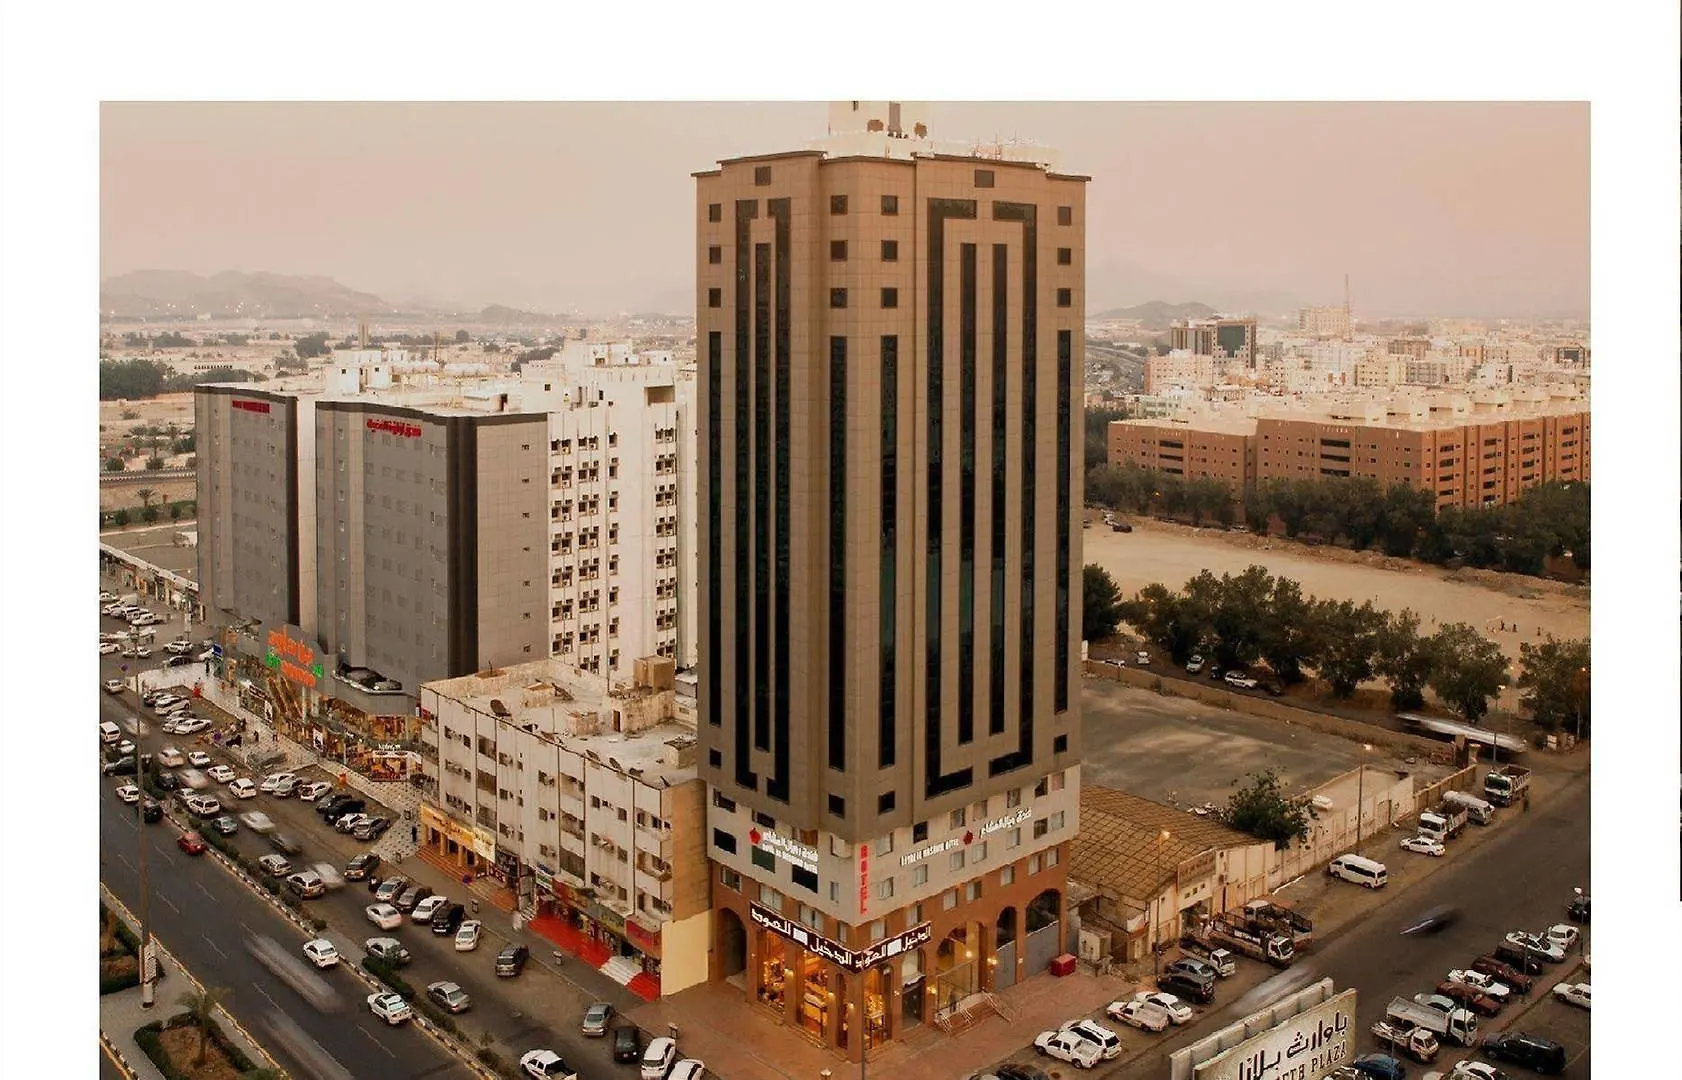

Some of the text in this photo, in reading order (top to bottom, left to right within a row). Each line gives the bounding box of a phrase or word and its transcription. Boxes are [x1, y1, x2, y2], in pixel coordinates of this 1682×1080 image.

[860, 844, 868, 915] HOTEL
[1286, 1011, 1348, 1059] باوارث
[1311, 1041, 1346, 1073] PLAZA
